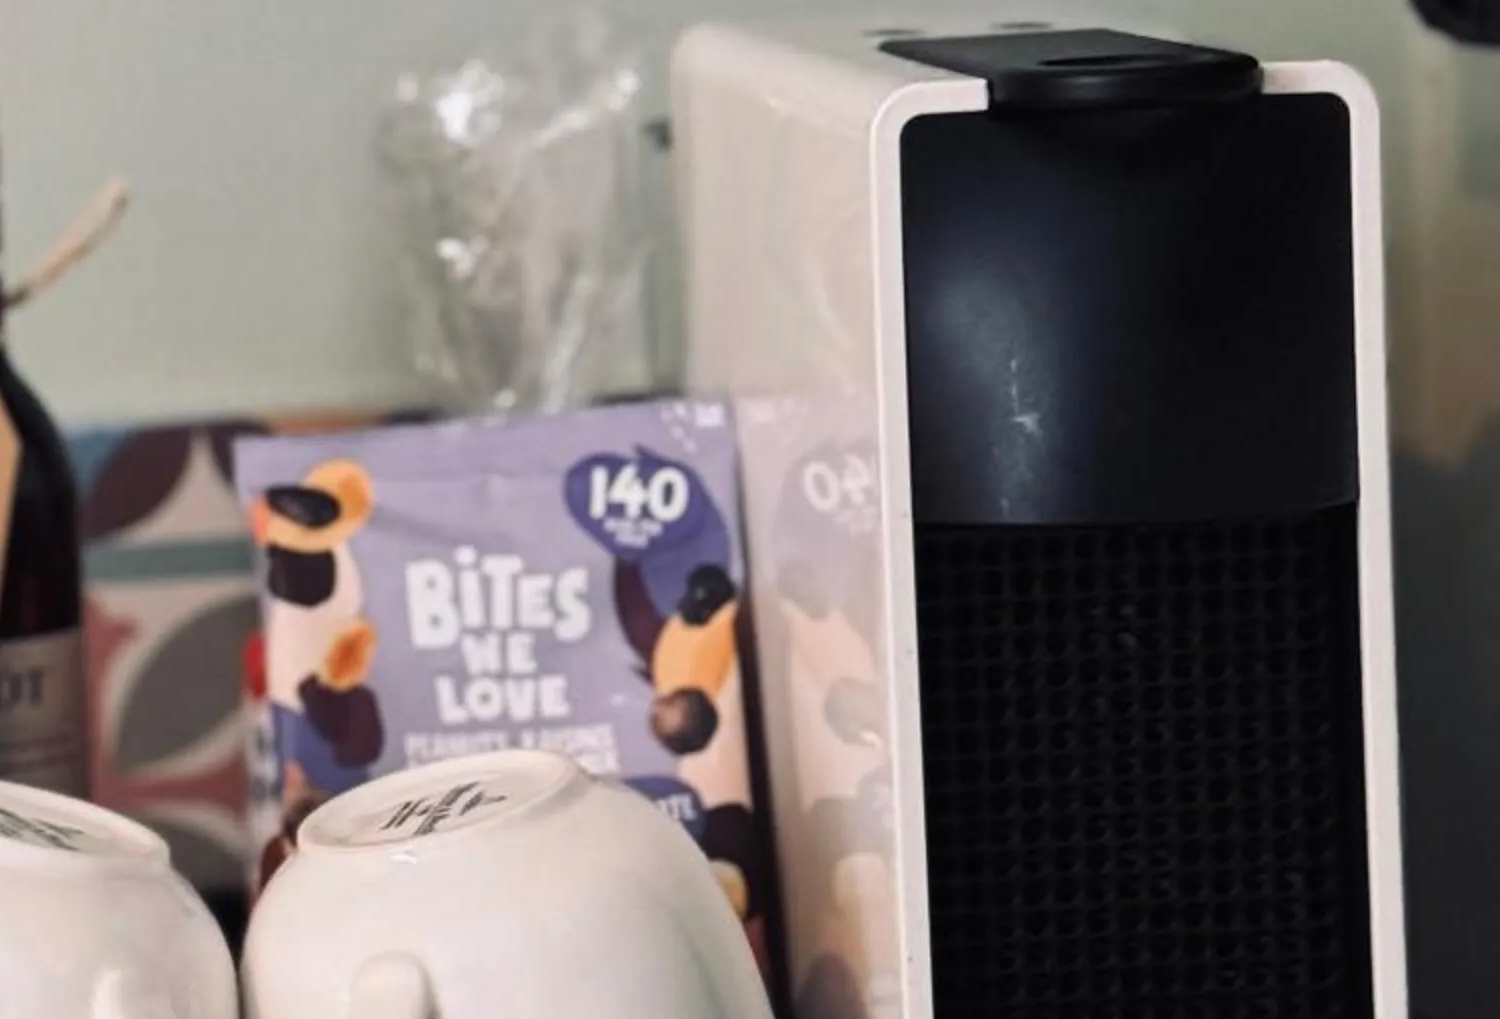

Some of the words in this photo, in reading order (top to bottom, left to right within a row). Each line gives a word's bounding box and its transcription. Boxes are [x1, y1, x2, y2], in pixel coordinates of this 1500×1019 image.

[589, 464, 689, 522] 140
[462, 632, 537, 675] WE
[435, 673, 571, 726] LOVE
